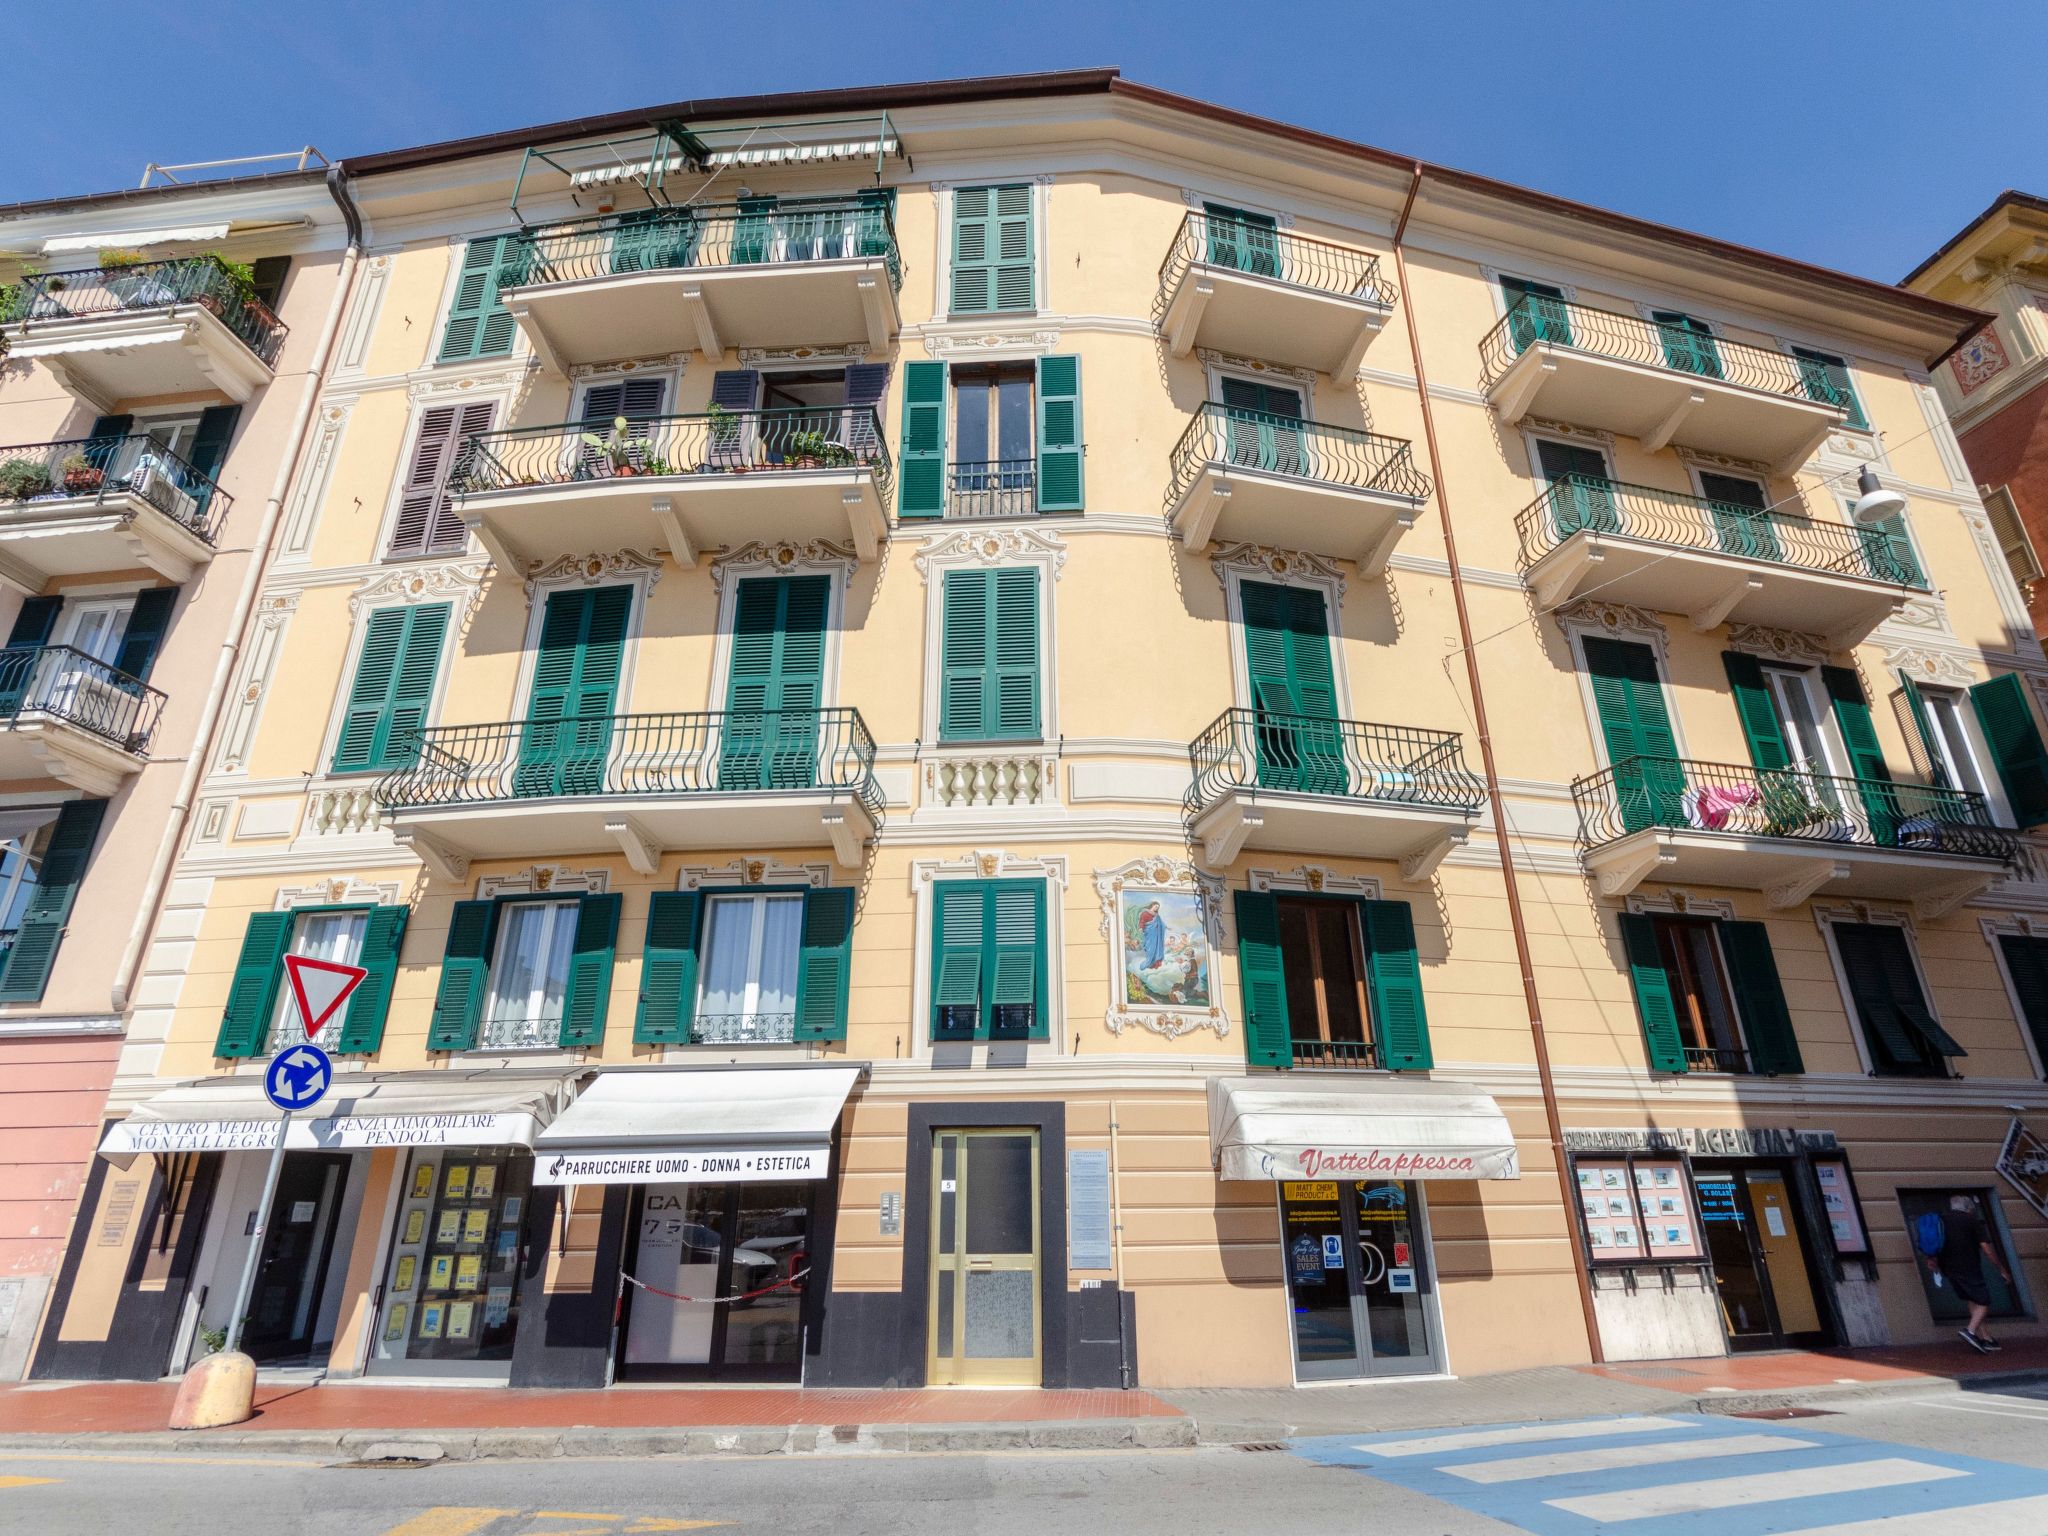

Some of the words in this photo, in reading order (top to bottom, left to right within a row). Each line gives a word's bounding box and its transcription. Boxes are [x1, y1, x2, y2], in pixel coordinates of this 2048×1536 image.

[139, 1121, 208, 1136] CENTRO
[323, 1117, 388, 1132] AGENZIA
[393, 1114, 497, 1130] IMMOBILIARE
[129, 1134, 279, 1151] MONTALLEGRO
[365, 1130, 447, 1144] PENDOLA
[565, 1160, 652, 1175] PARRUCCHIERE
[656, 1159, 689, 1173] UOMO
[701, 1158, 741, 1172] DONNA
[756, 1156, 811, 1171] ESTETICA
[1298, 1149, 1475, 1178] Vattelappesca
[1316, 1183, 1333, 1191] CHEM
[647, 1195, 682, 1210] CA
[1296, 1191, 1325, 1199] PRODUCT
[1296, 1254, 1319, 1263] SALES
[1296, 1262, 1320, 1271] EVENT
